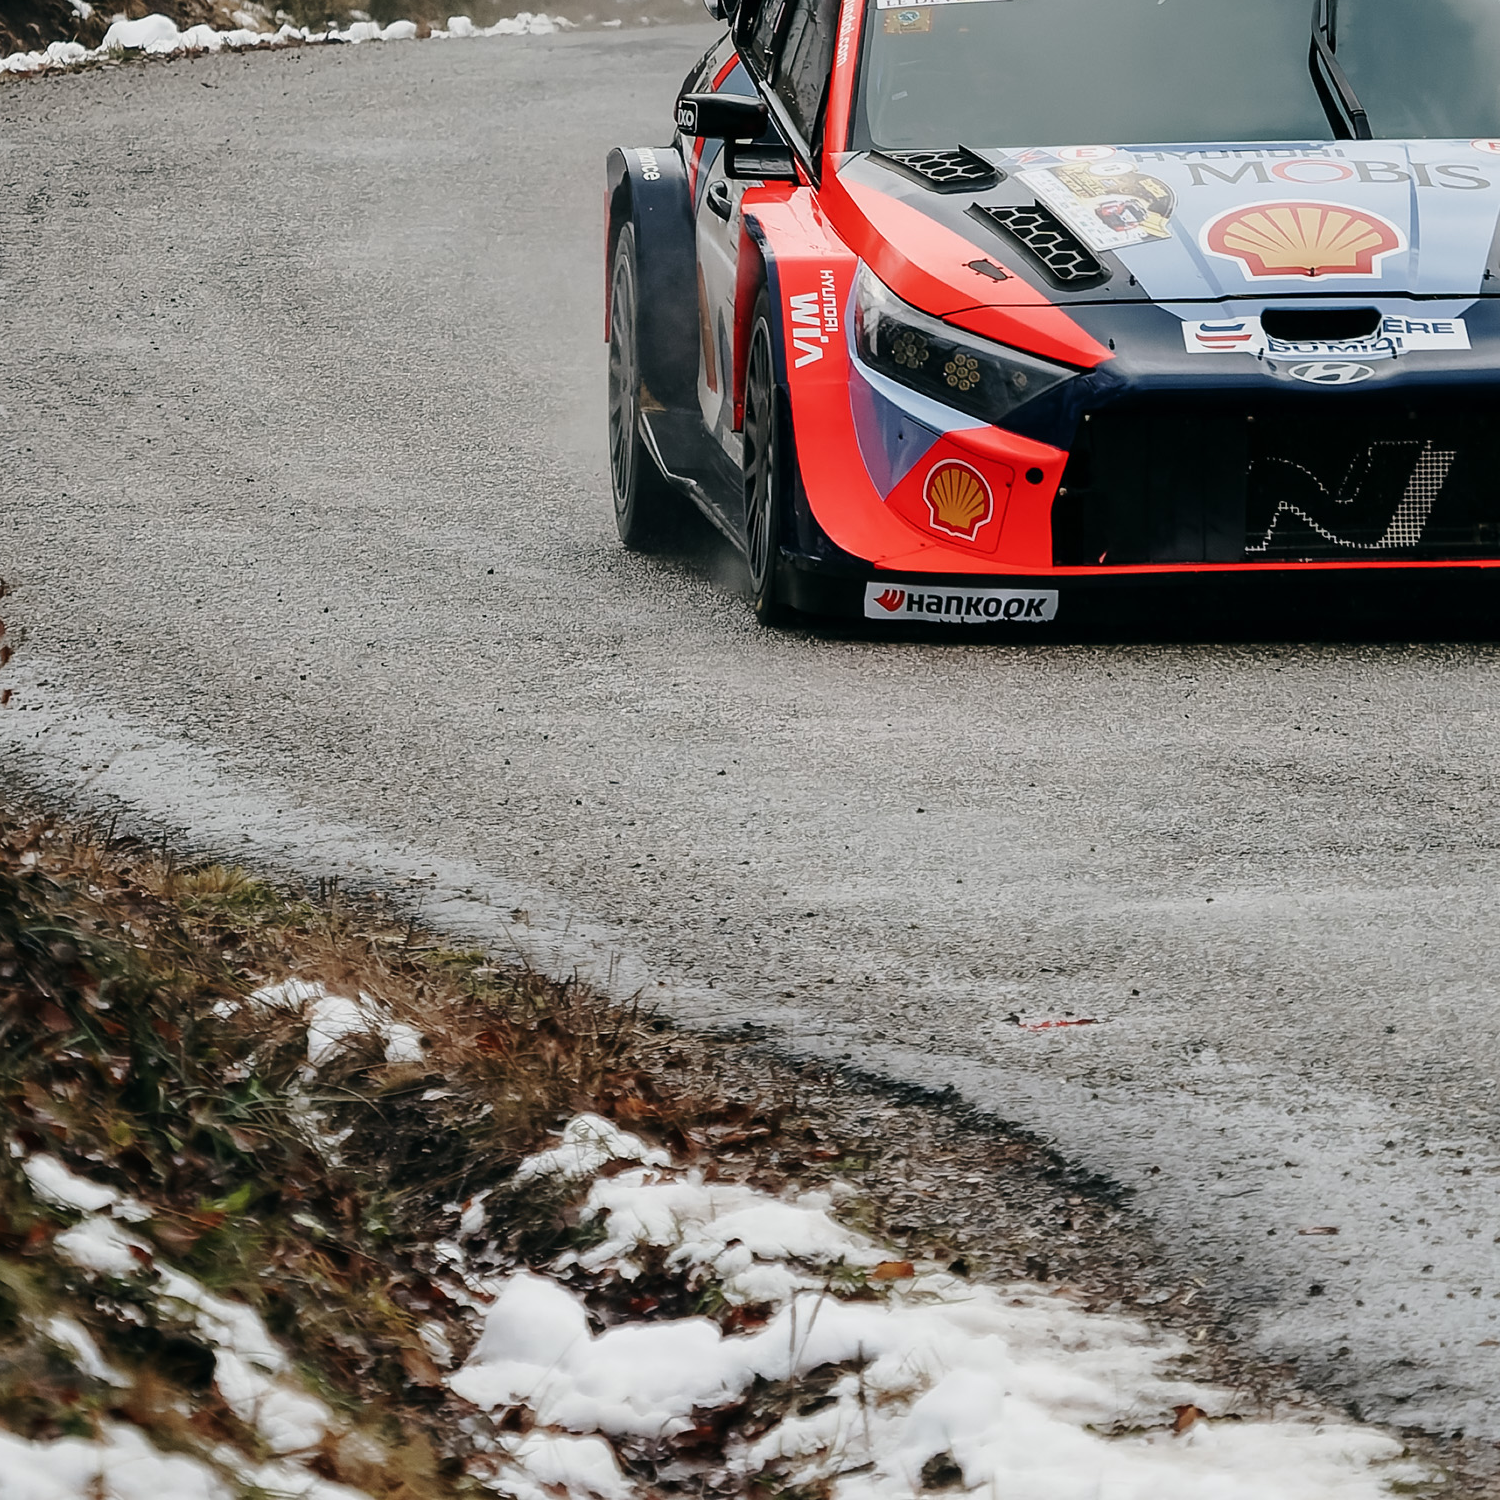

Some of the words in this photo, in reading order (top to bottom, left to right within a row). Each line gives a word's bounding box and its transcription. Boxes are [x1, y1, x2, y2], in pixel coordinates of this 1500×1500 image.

[1075, 148, 1099, 158] E
[1134, 149, 1345, 162] HYUNDAI
[1182, 159, 1491, 190] MOBIS
[820, 269, 839, 332] HYUNDAI
